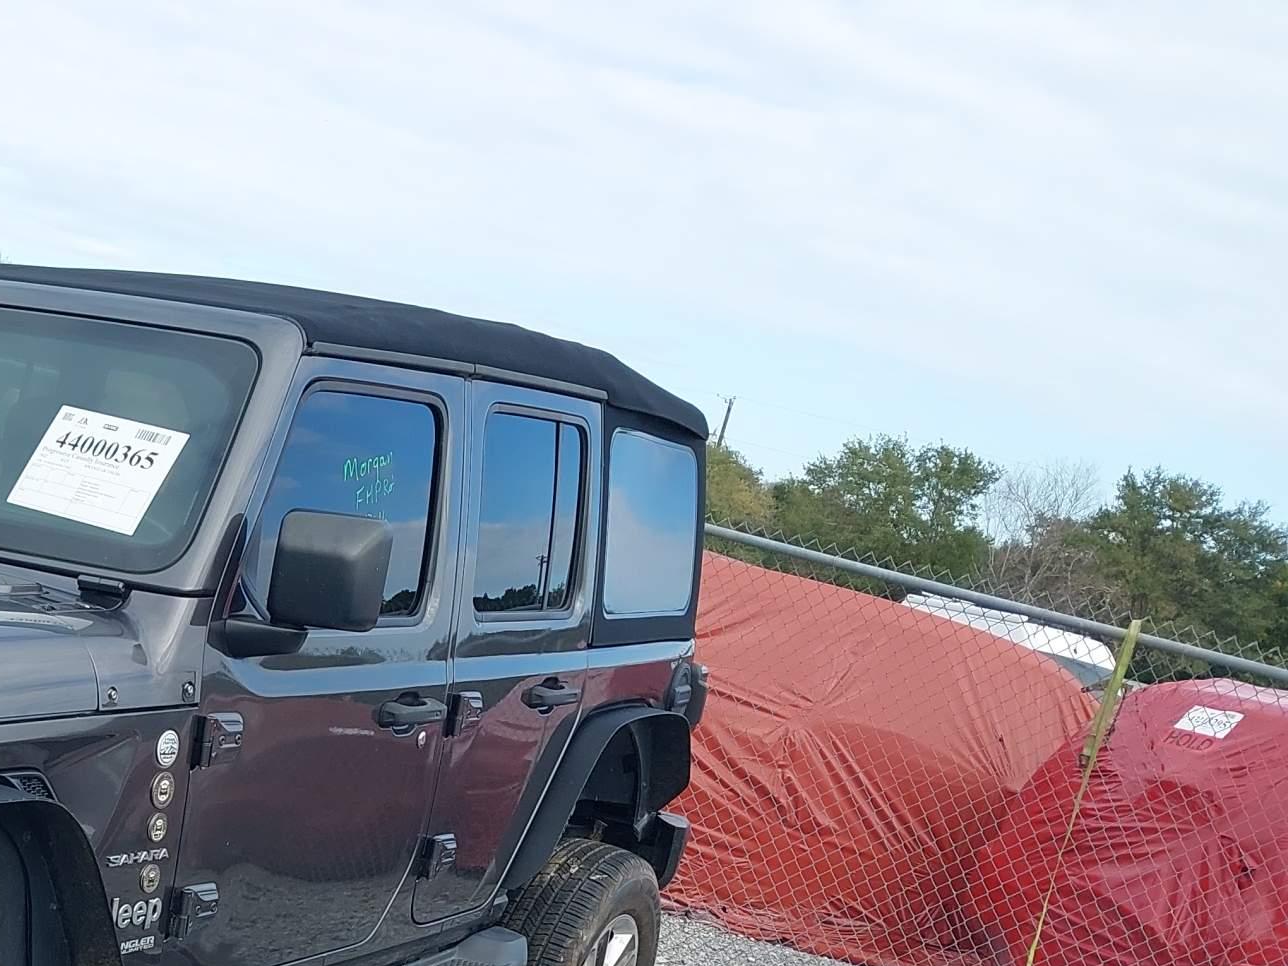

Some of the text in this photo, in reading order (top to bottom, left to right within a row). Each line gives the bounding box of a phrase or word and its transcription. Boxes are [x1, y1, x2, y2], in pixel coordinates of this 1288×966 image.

[55, 431, 159, 469] 44000365
[106, 848, 170, 867] SAHARA
[112, 897, 163, 931] Jeep
[120, 936, 154, 951] NGLER
